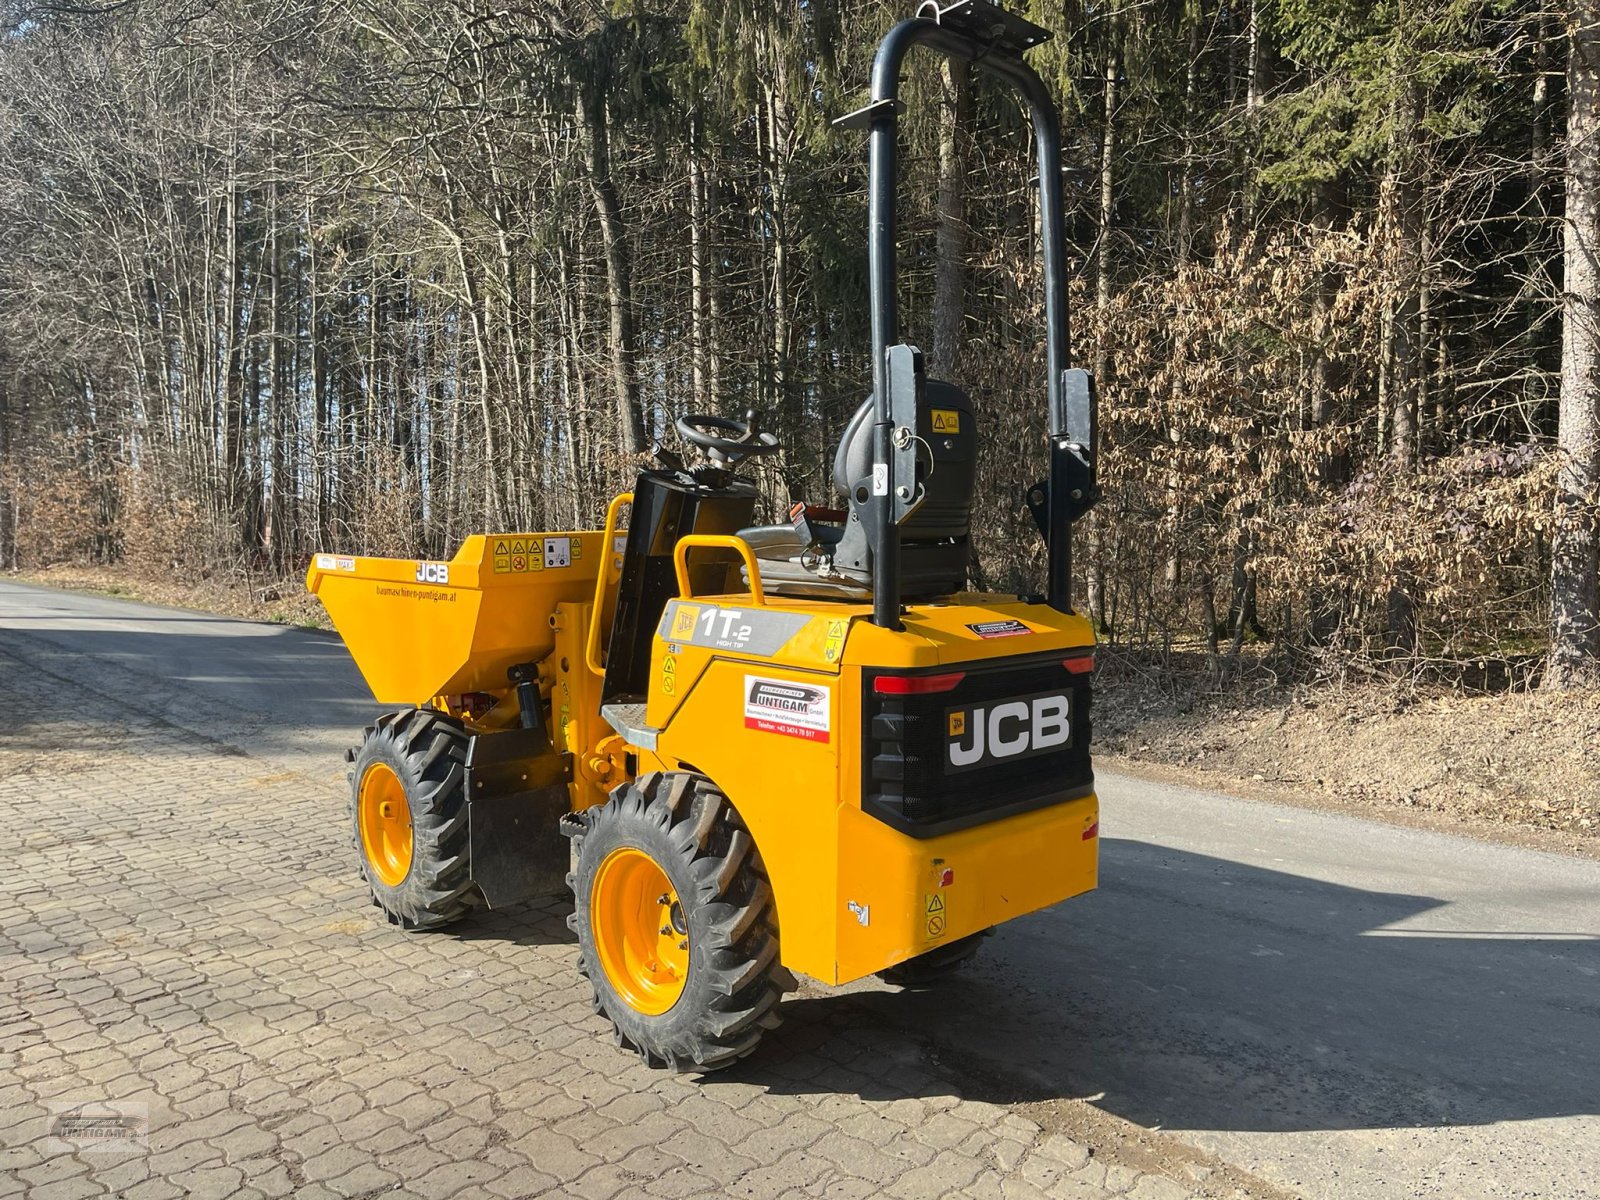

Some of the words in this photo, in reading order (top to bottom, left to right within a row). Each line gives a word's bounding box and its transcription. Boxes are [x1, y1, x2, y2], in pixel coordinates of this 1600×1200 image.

[416, 562, 449, 584] JCB
[376, 585, 457, 604] baumaschinen-puntigam.at
[716, 640, 732, 648] HIGH
[761, 686, 804, 697] BAUMASCHINEN
[757, 720, 776, 730] Telefon:
[949, 695, 1070, 767] JCB
